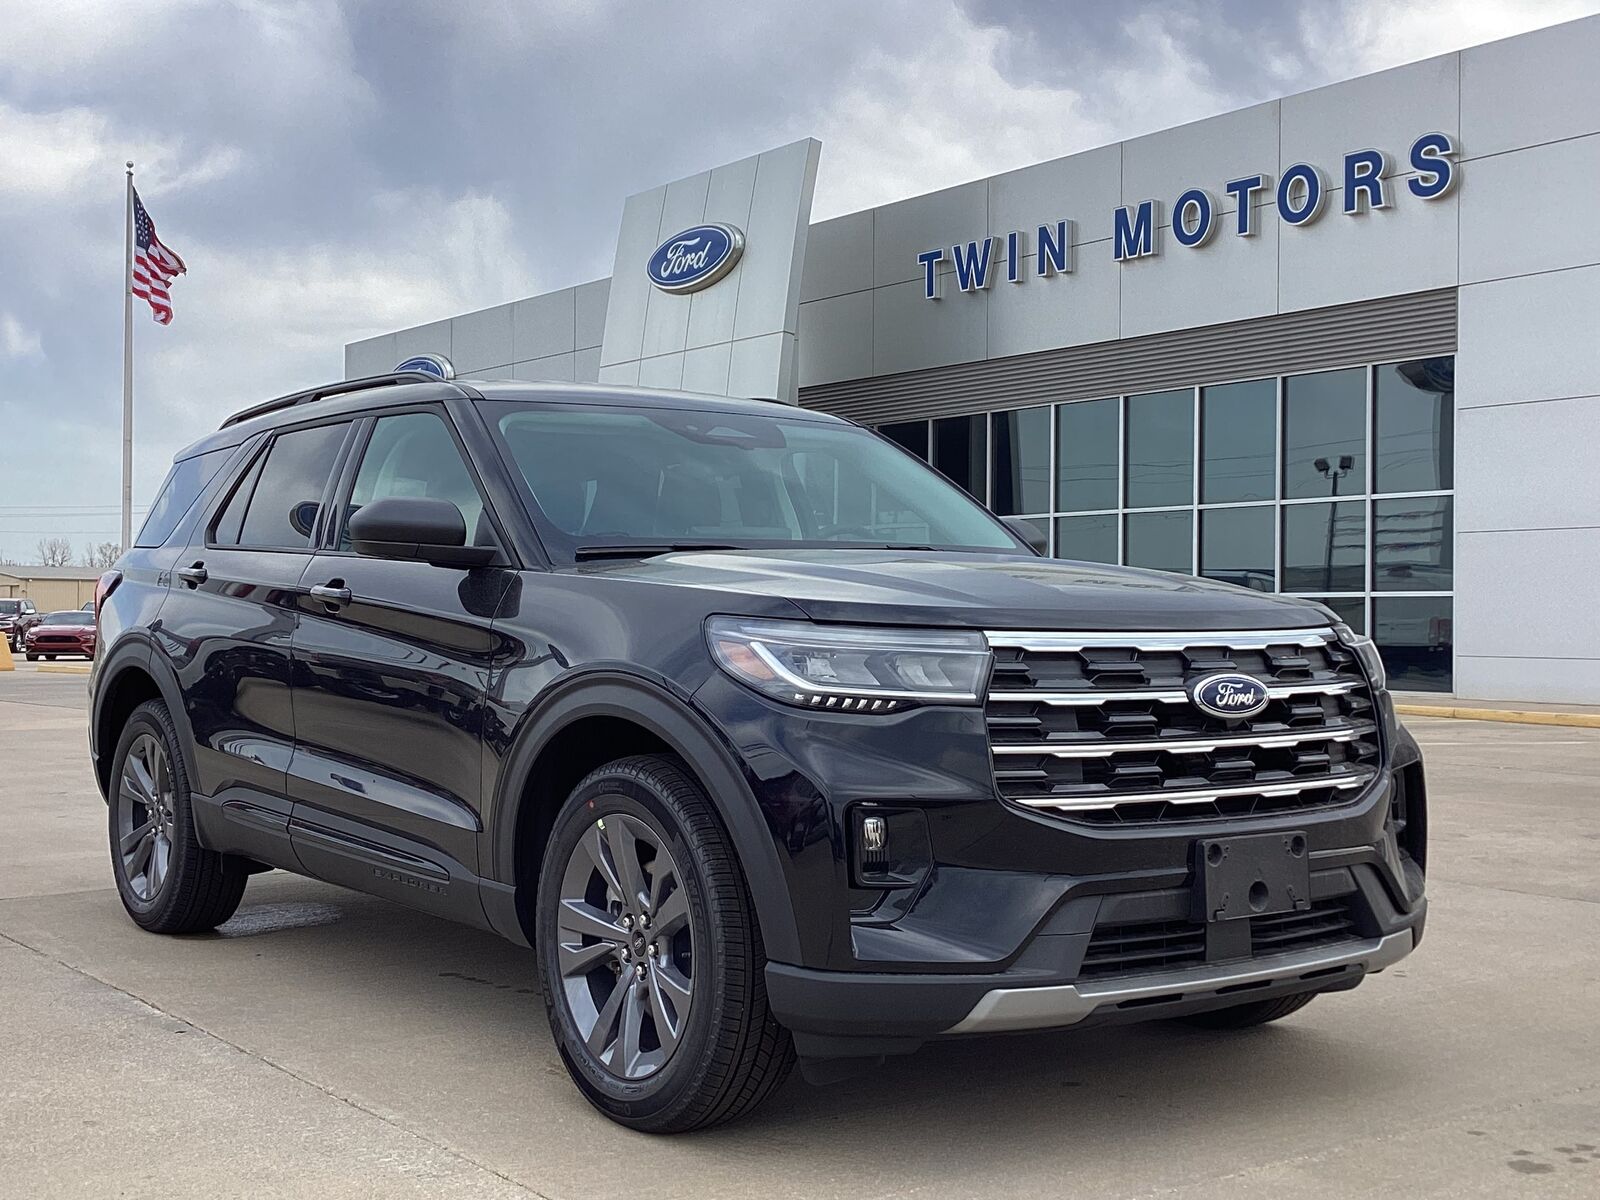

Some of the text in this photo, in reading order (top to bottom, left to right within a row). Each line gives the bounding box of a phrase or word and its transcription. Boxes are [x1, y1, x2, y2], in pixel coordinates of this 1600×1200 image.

[917, 132, 1458, 300] TWIN MOTORS
[661, 237, 711, 278] Ford
[1216, 682, 1256, 707] Ford
